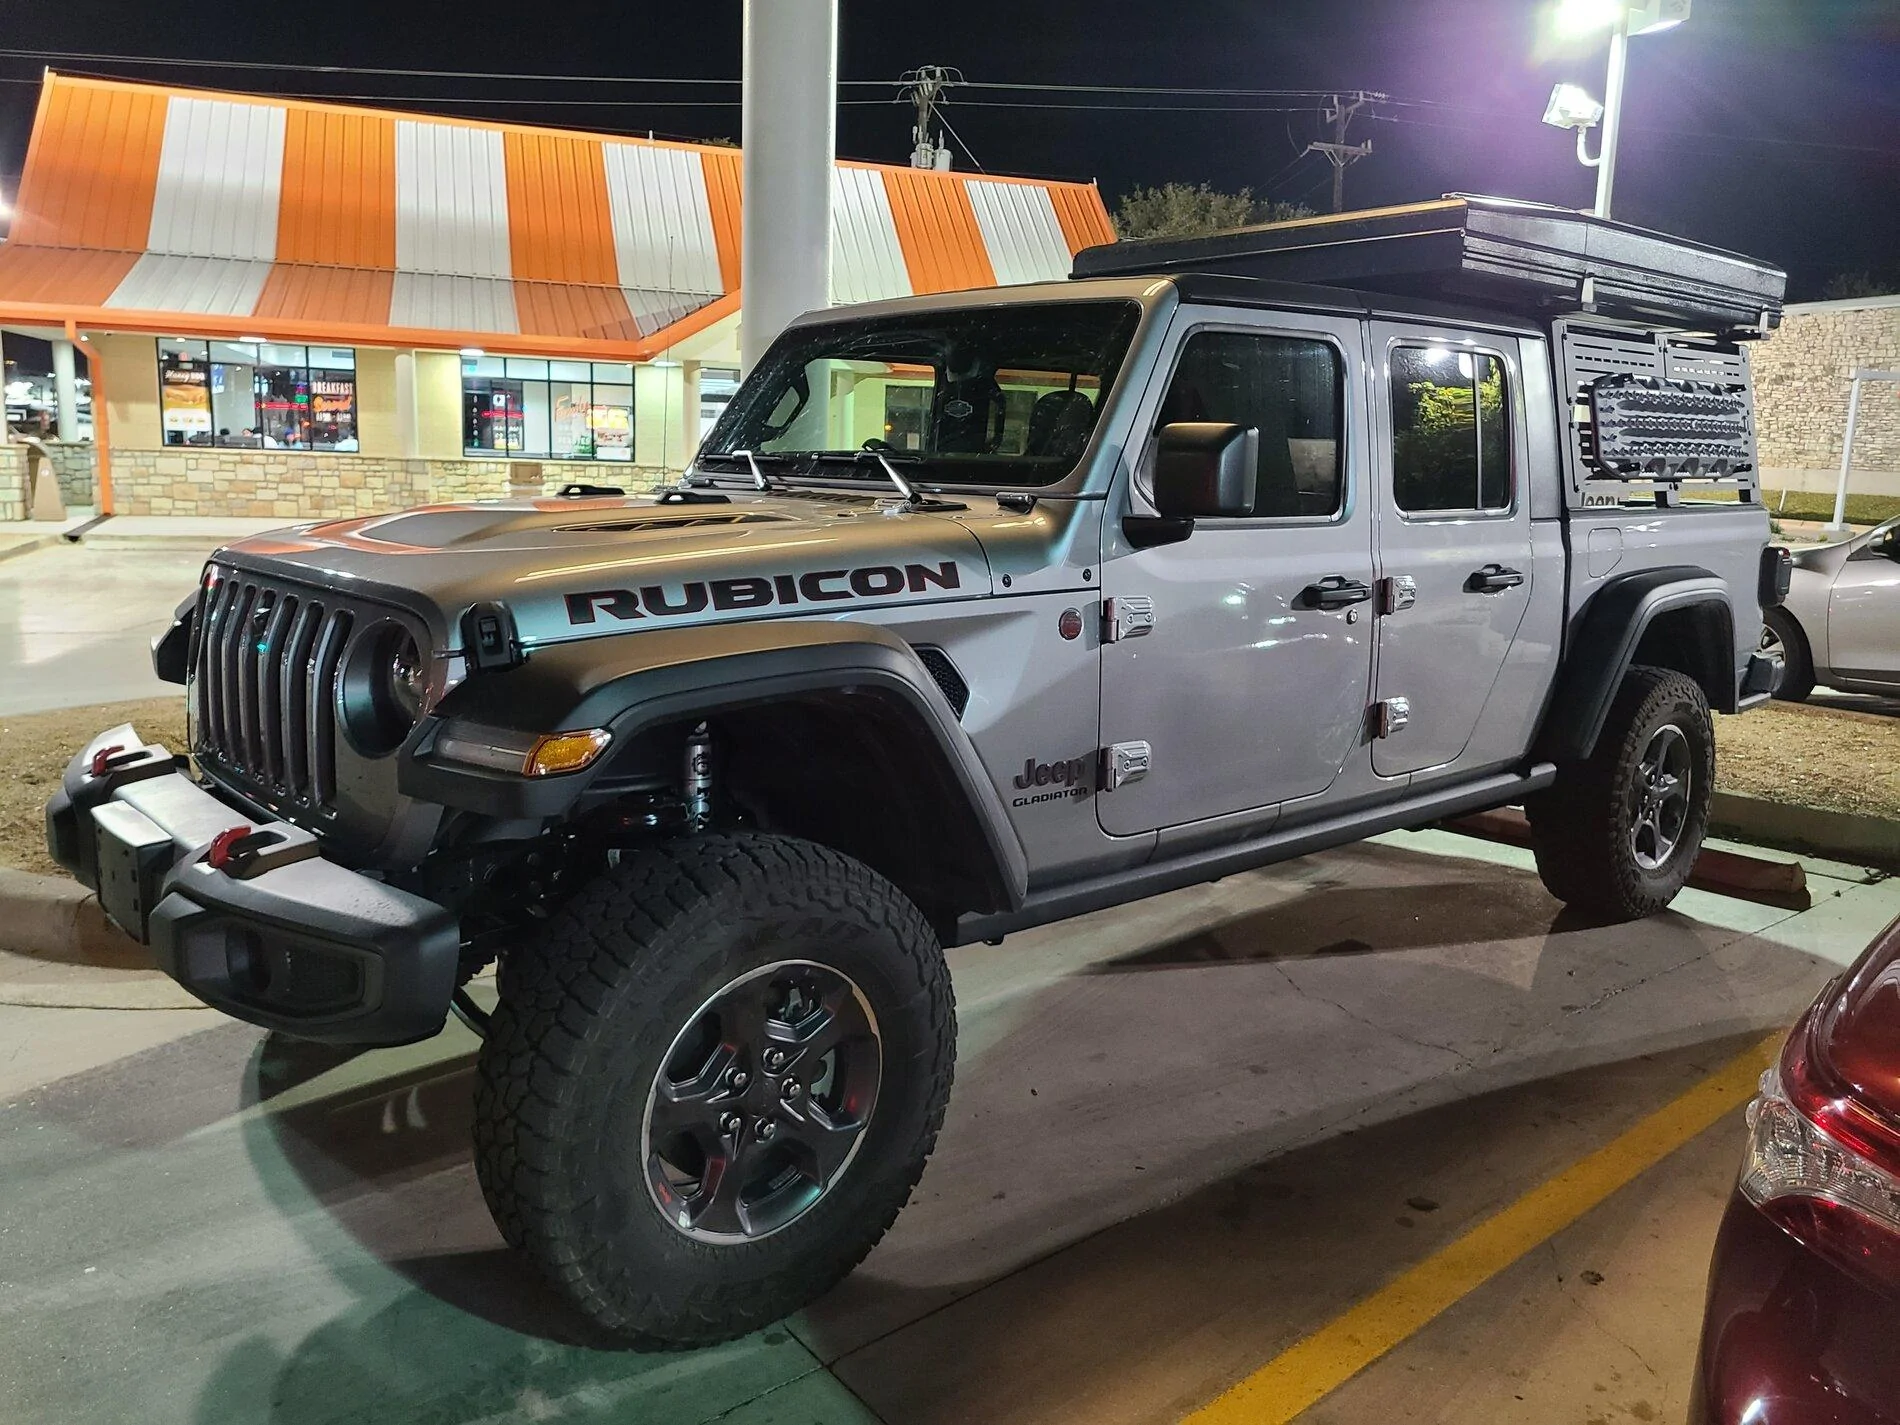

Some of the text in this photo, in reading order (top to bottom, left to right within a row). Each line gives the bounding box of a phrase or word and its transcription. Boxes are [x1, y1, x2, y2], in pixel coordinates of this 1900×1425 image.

[311, 381, 353, 394] BREAKFAST
[563, 561, 960, 625] RUBICON
[1013, 757, 1084, 788] Jeep
[1012, 787, 1088, 807] GLADIATOR
